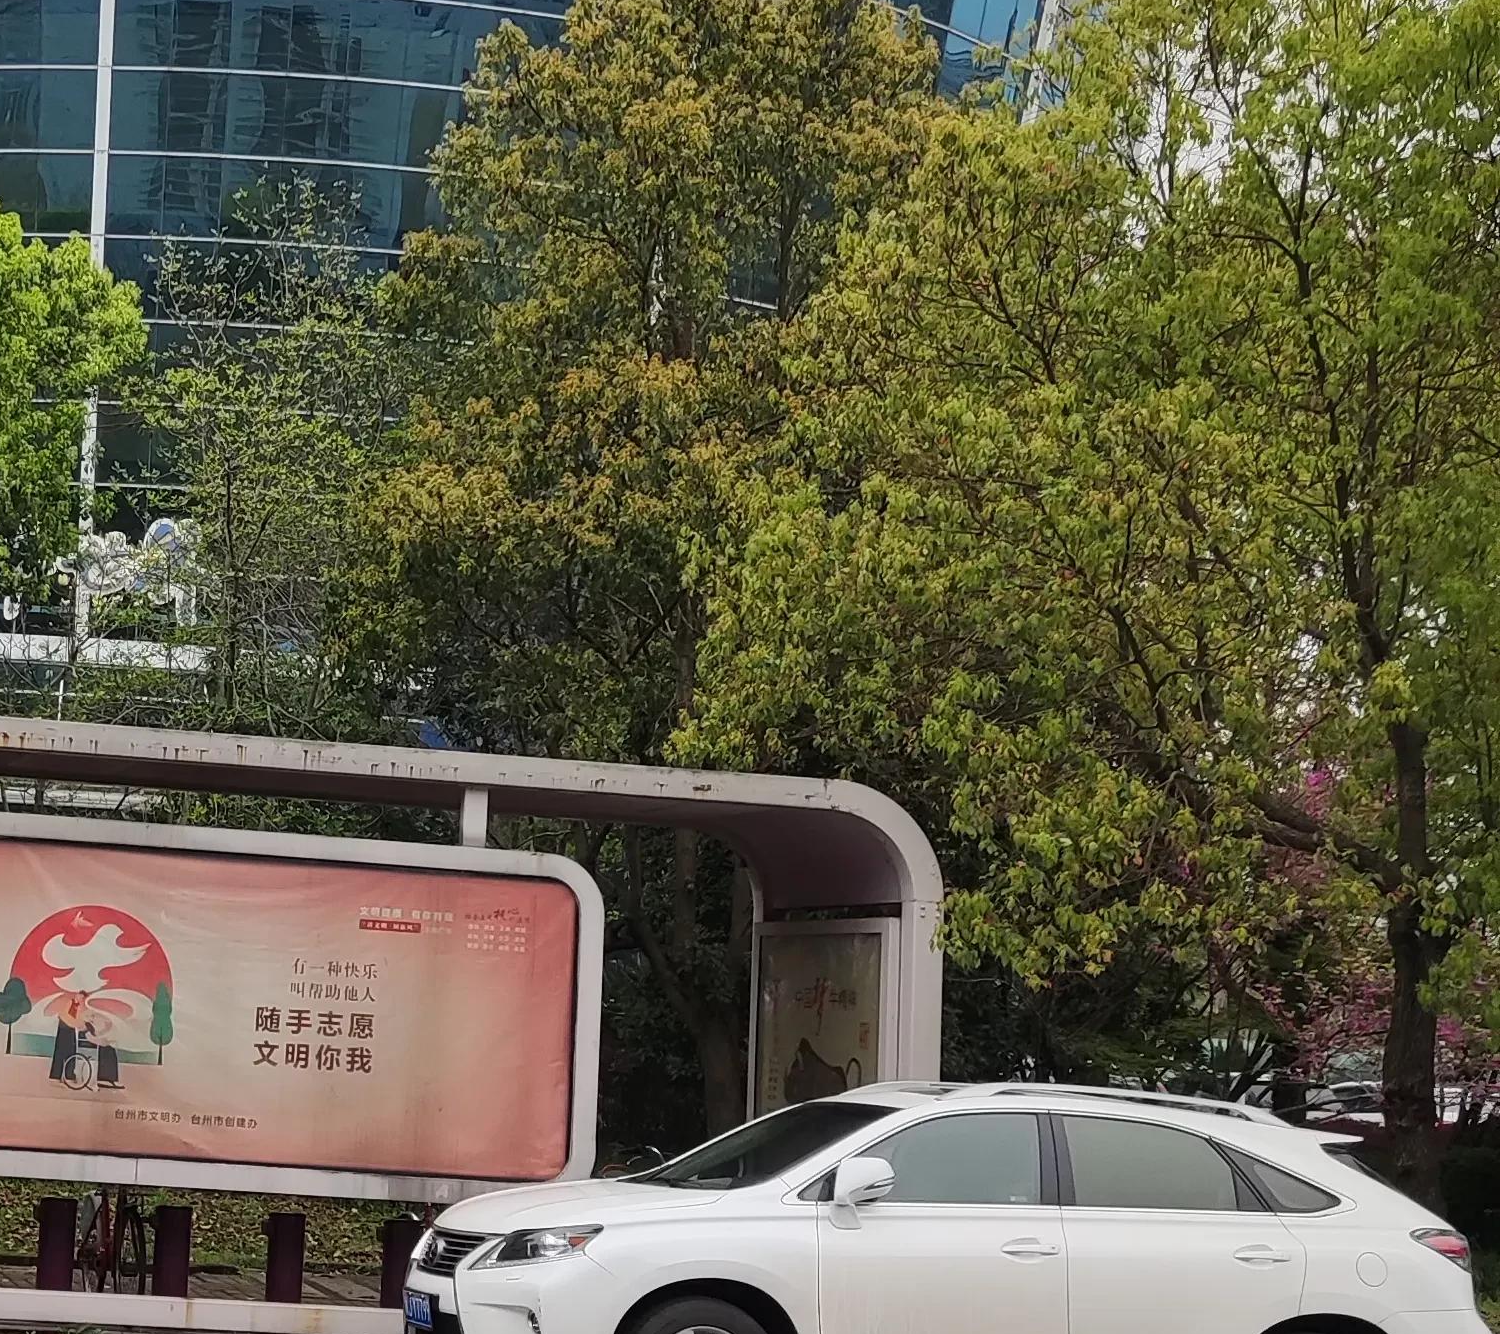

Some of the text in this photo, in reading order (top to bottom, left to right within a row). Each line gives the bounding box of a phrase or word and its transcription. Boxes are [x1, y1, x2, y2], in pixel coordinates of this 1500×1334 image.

[293, 957, 378, 979] 有一种快乐
[290, 982, 376, 1002] 叫帮助他人
[255, 1006, 375, 1039] 随手志愿
[253, 1040, 373, 1073] 文明你我
[115, 1108, 257, 1129] 台州市文明办 台州市创建办
